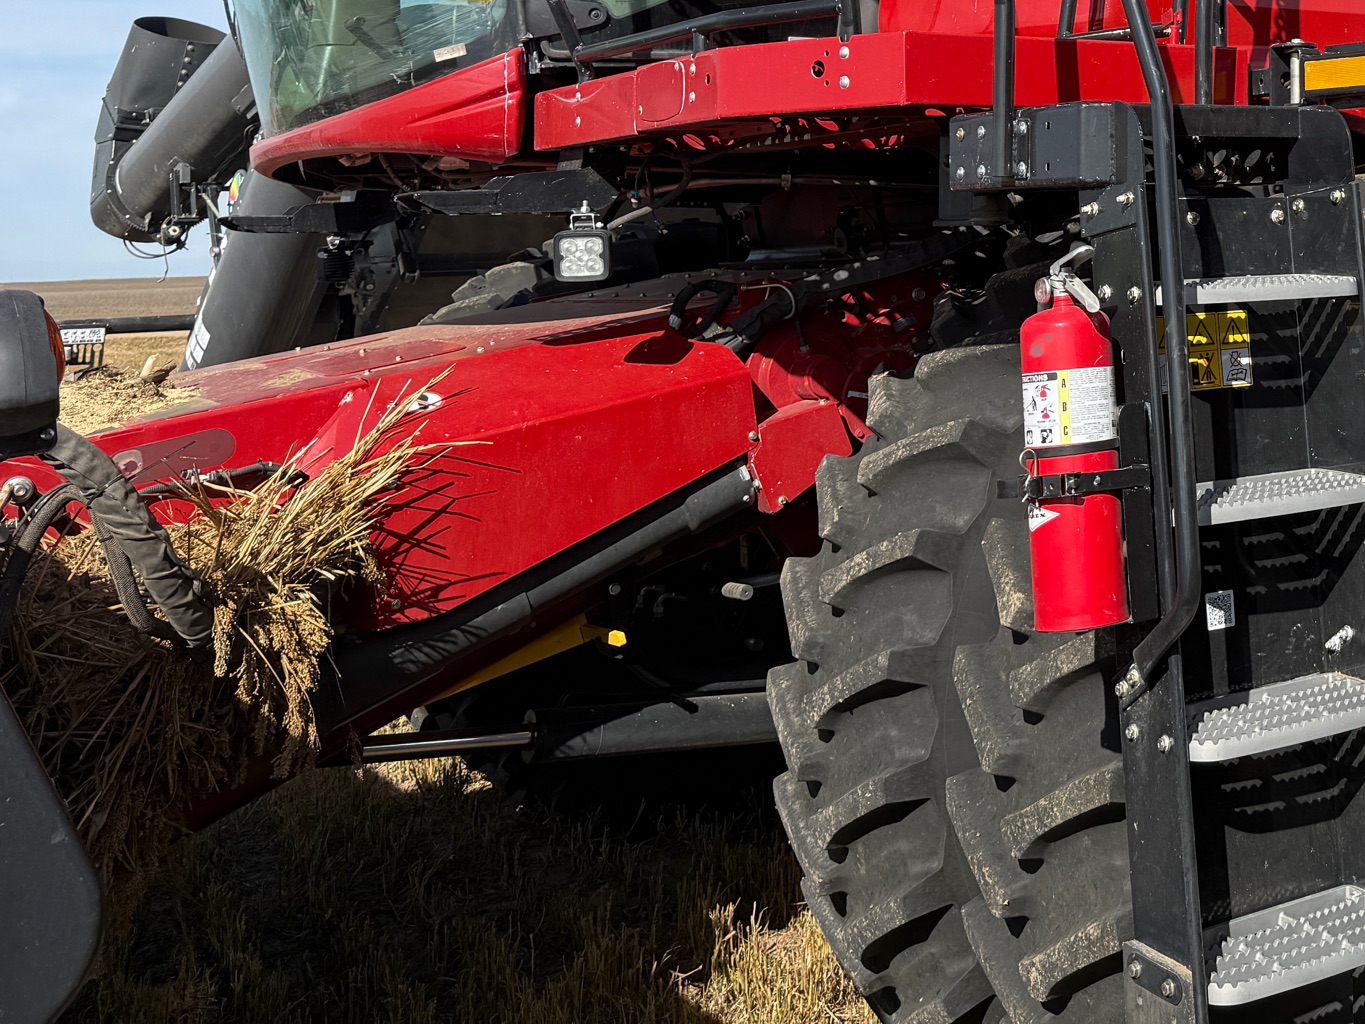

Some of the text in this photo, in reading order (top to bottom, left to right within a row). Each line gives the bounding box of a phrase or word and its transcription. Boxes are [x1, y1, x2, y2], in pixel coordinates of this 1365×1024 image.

[1061, 378, 1067, 389] A
[1062, 401, 1067, 412] B
[1063, 425, 1069, 436] C
